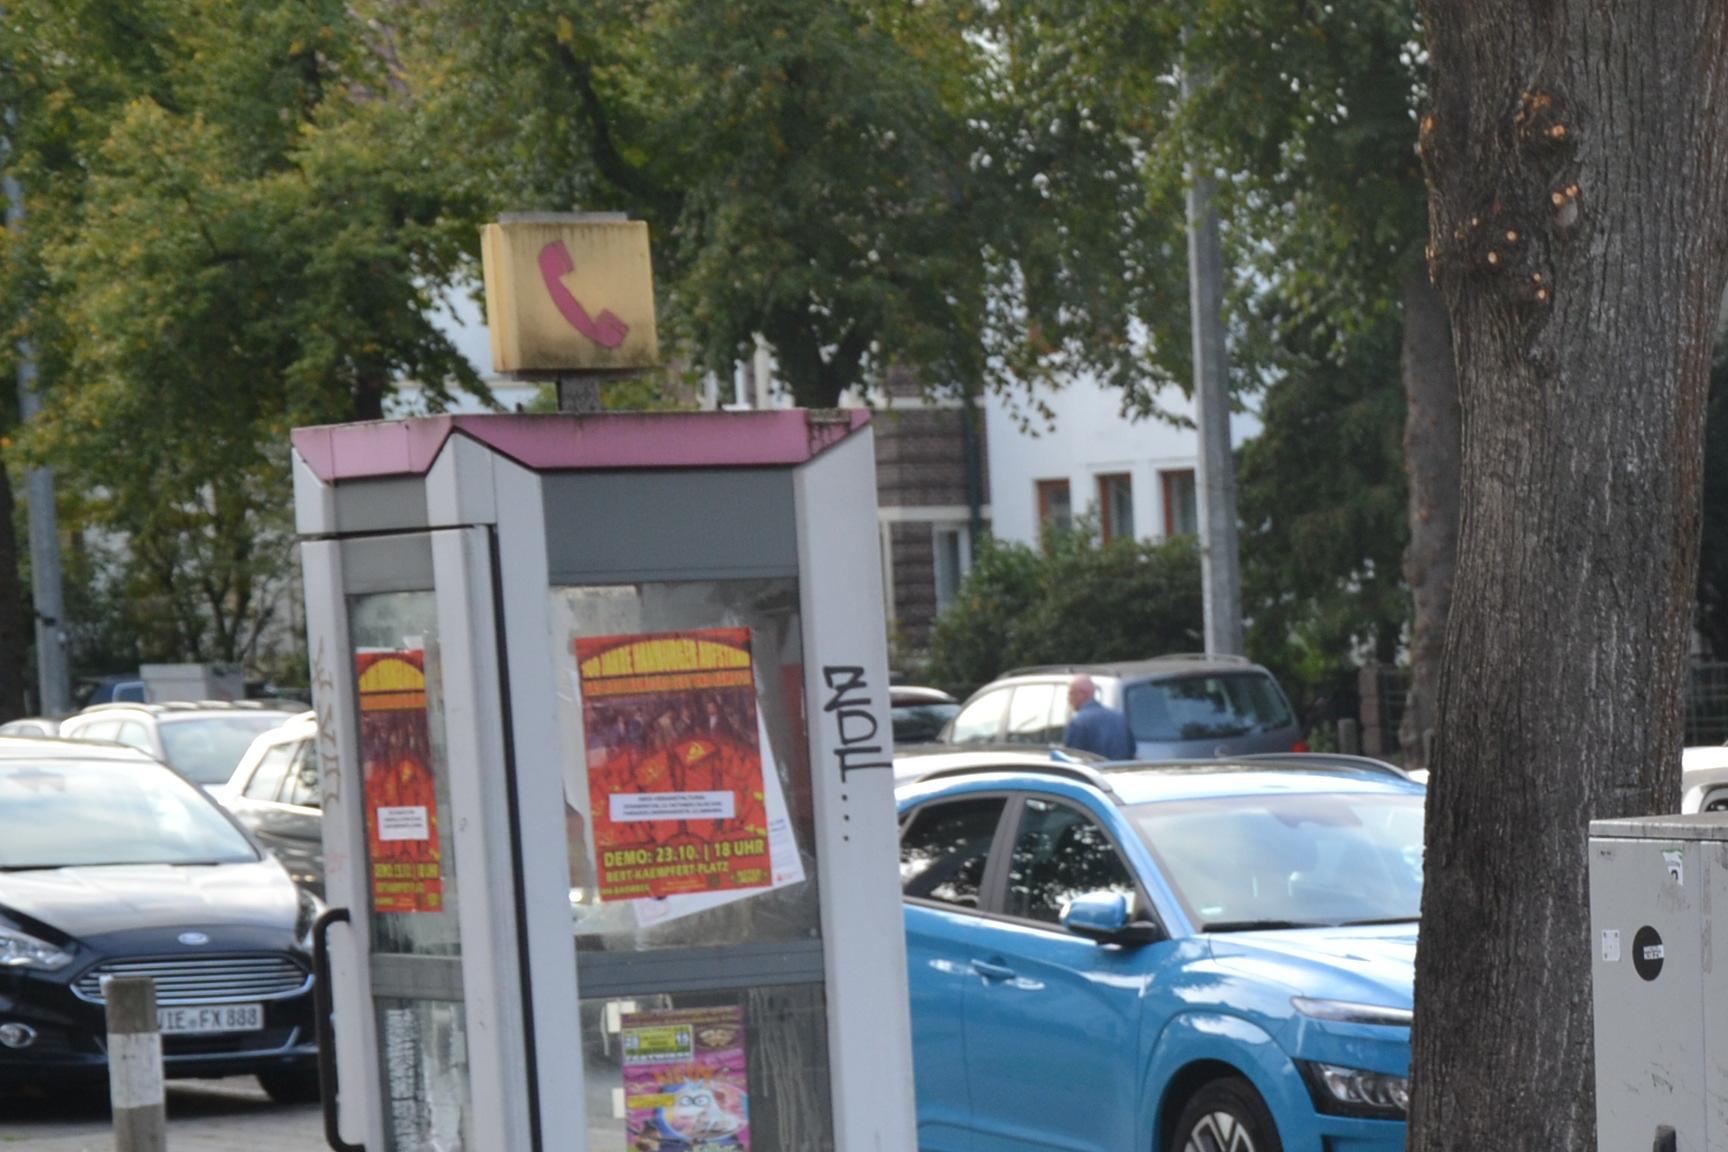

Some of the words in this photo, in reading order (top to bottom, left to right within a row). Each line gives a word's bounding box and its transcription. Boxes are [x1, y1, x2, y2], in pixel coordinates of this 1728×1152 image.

[603, 849, 654, 868] DEMO:
[714, 841, 731, 857] 18
[734, 839, 765, 856] UHR
[199, 1008, 221, 1028] FX
[226, 1007, 257, 1026] 888
